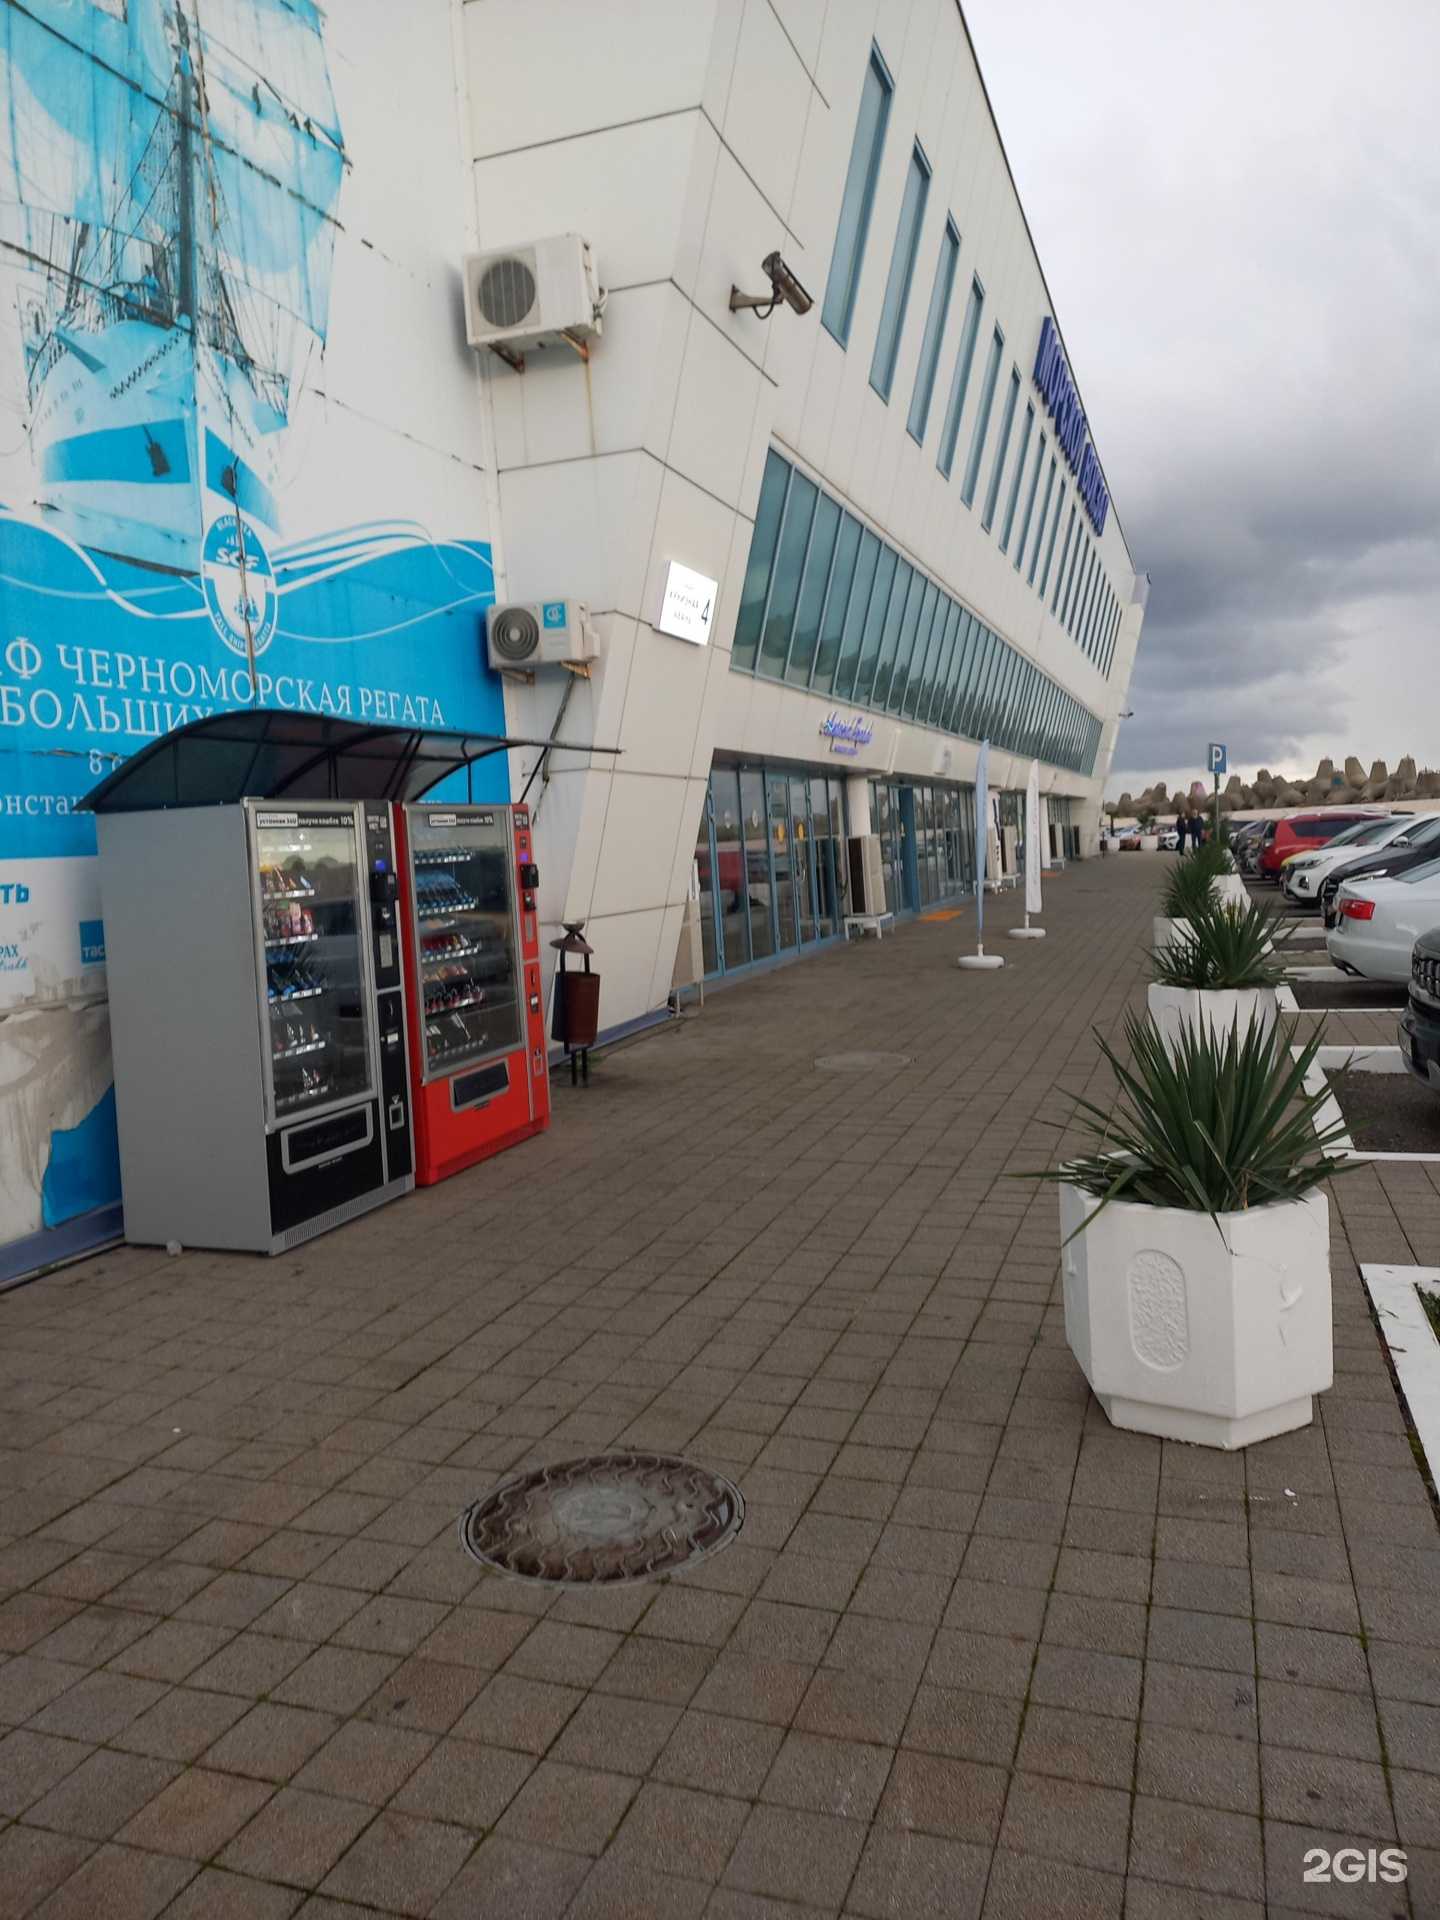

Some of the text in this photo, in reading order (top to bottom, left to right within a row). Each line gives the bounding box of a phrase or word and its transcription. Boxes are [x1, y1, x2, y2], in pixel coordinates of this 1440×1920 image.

[701, 599, 710, 625] 4
[56, 643, 352, 716] ЧЕРНОМОРСКАЯ
[358, 687, 446, 726] РЕГАТА
[1212, 746, 1223, 770] P
